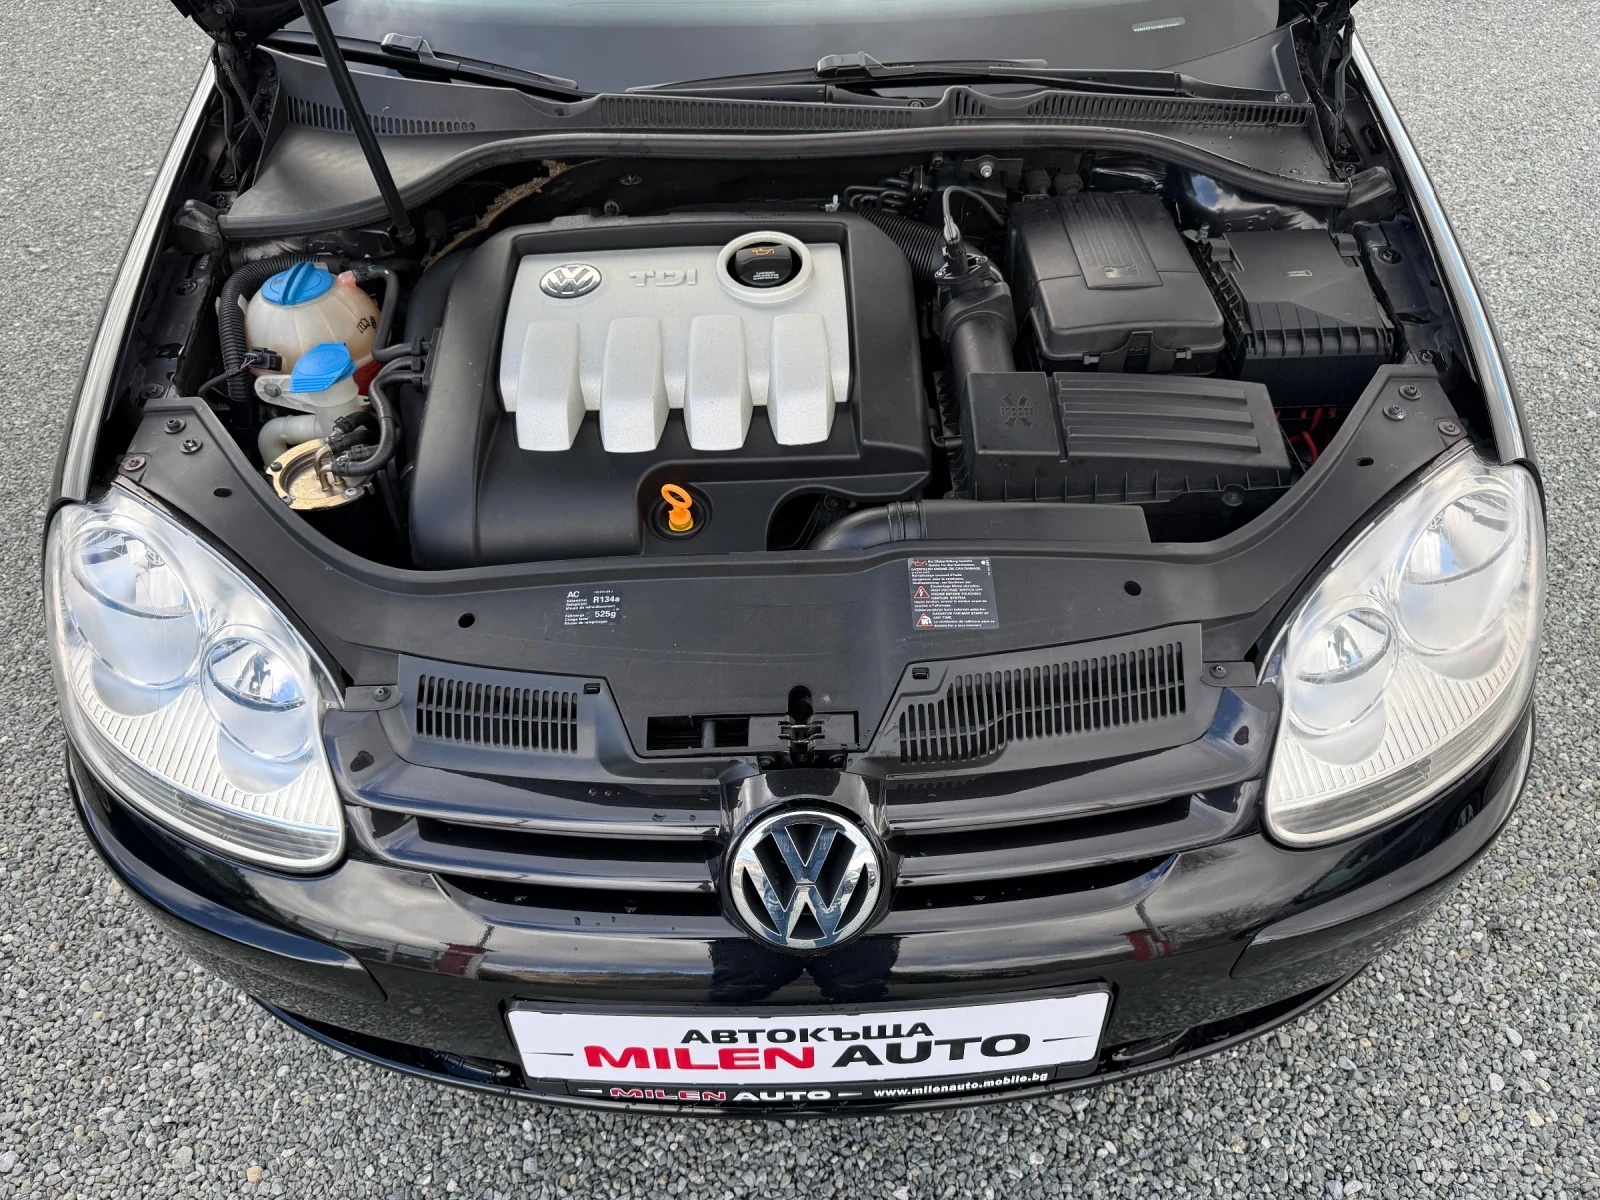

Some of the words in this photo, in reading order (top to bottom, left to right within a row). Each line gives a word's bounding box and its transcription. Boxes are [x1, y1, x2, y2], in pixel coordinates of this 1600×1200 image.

[629, 268, 698, 287] TDI
[584, 1045, 815, 1070] MILEN
[831, 1033, 1031, 1068] AUTO
[609, 1087, 727, 1101] MILEN
[732, 1090, 831, 1101] AUTO
[873, 1071, 1049, 1098] www.milenauto.mobile.bg
